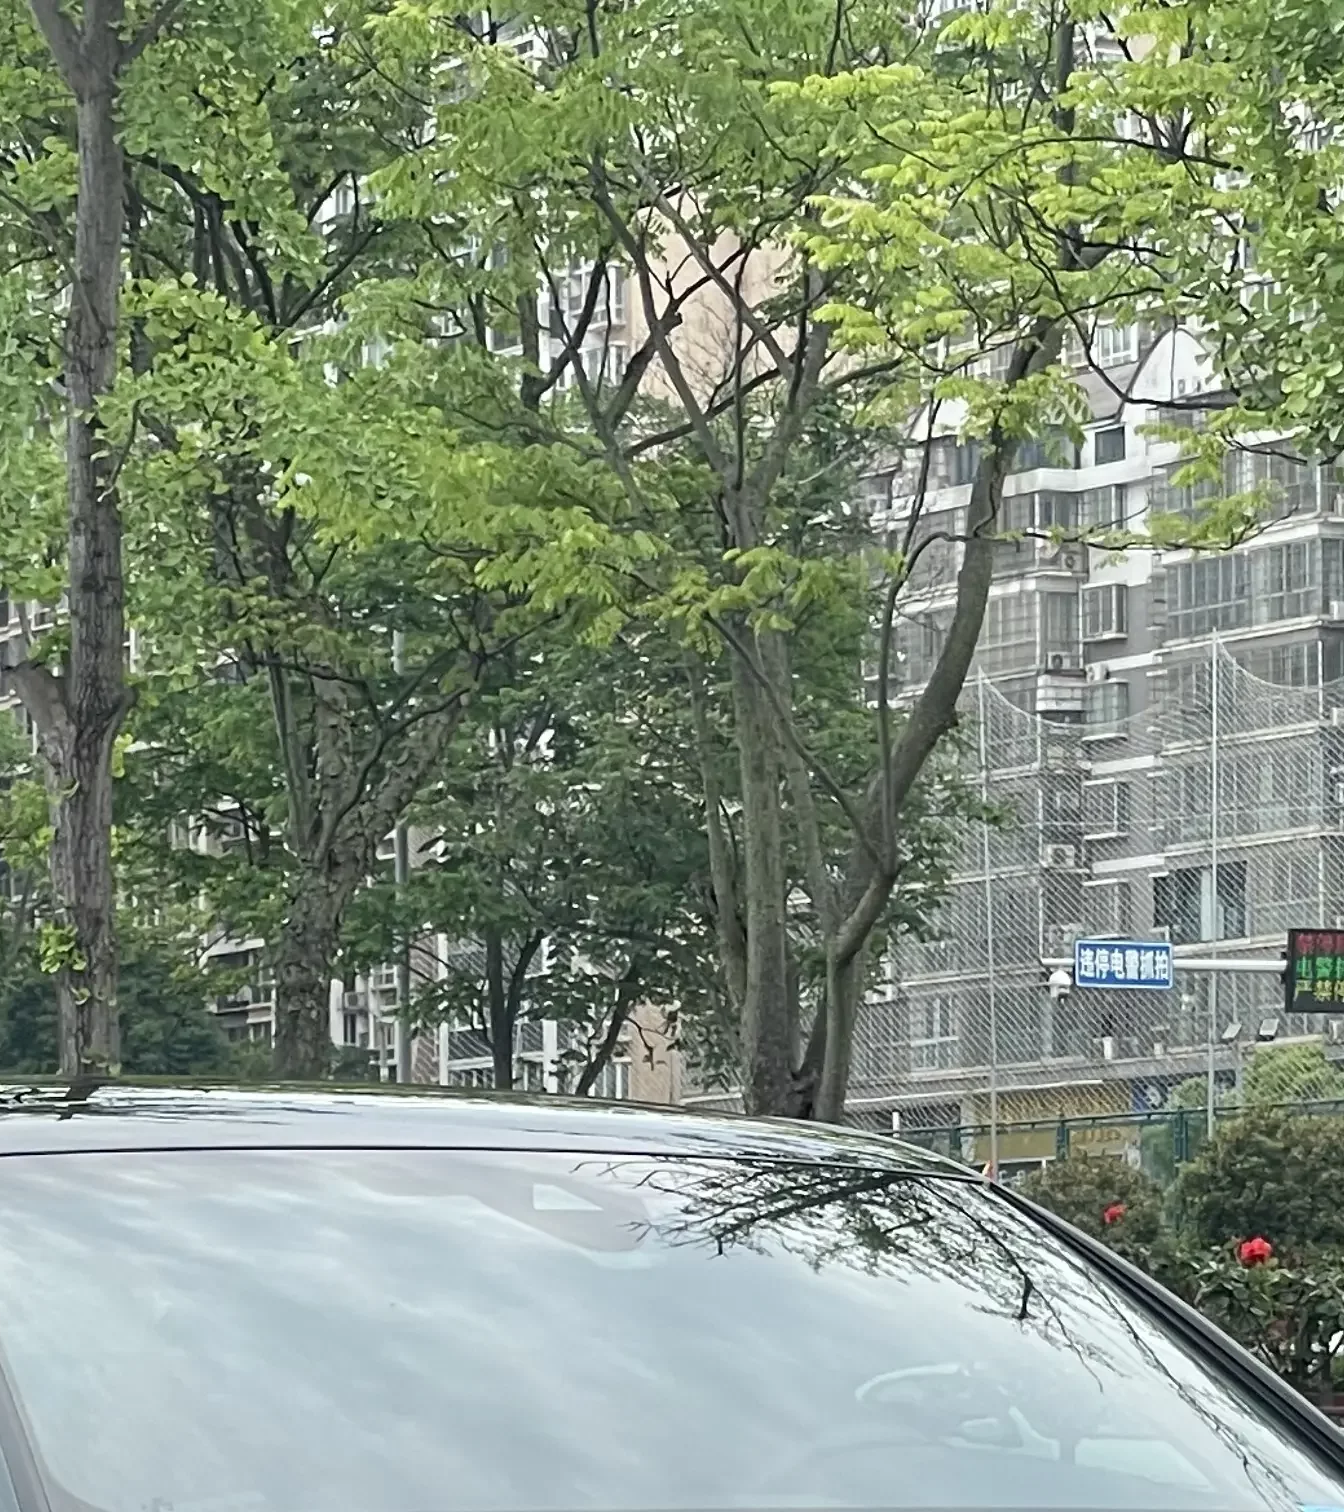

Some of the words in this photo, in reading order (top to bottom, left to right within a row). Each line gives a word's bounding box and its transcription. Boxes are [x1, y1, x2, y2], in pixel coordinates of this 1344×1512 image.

[1079, 947, 1169, 980] 违停电警抓拍
